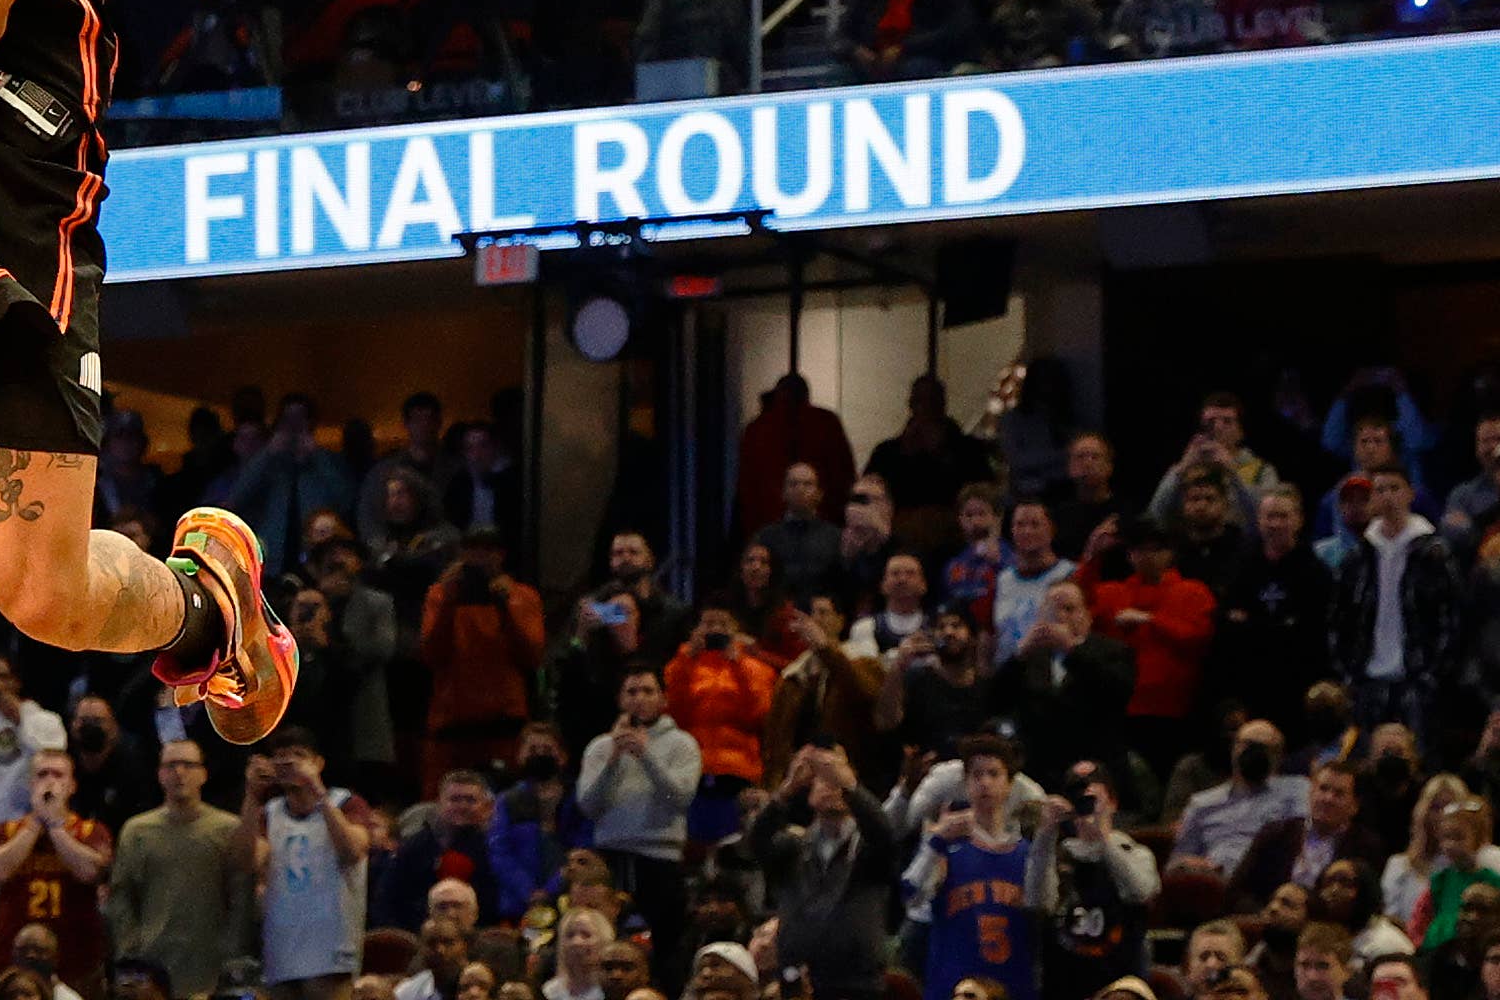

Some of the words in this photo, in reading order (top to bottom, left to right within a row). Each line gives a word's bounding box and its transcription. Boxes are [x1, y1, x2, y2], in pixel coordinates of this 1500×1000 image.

[184, 130, 536, 263] FINAL
[573, 90, 1027, 223] ROUND
[28, 880, 61, 918] 21
[978, 915, 1012, 965] 5
